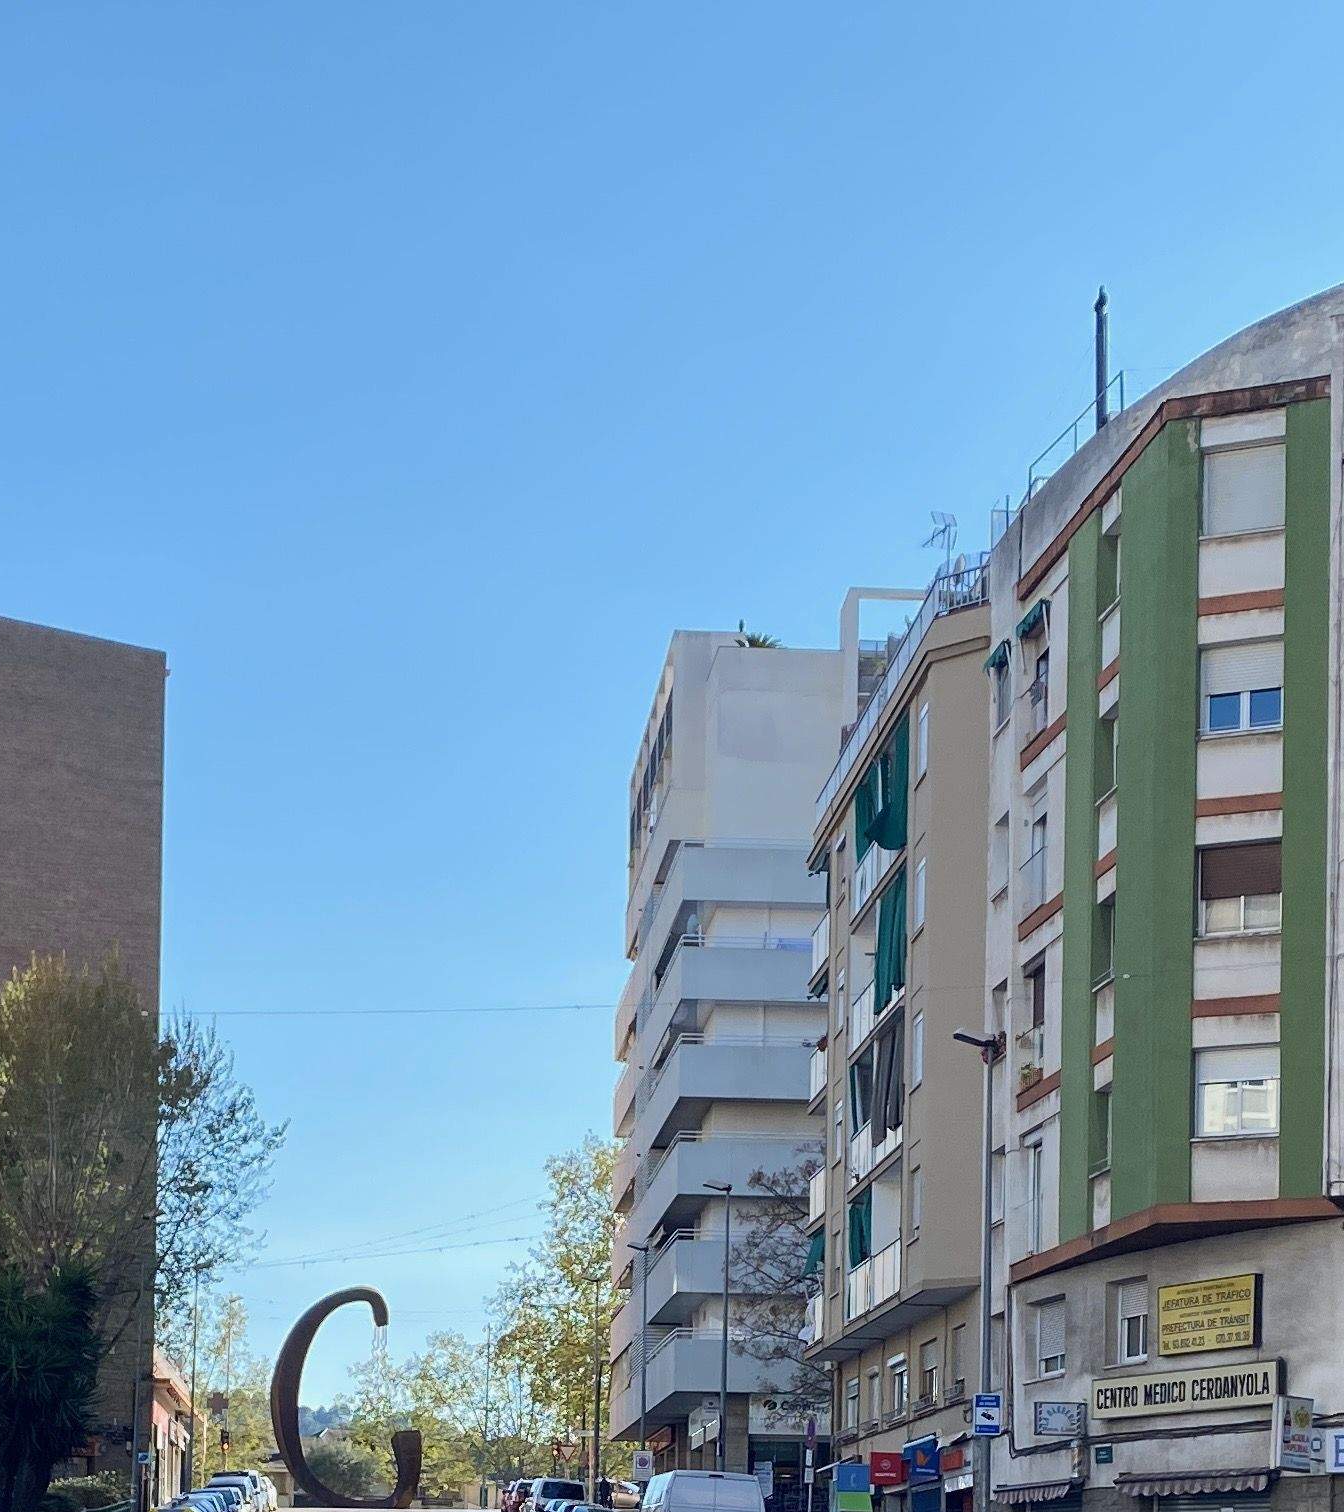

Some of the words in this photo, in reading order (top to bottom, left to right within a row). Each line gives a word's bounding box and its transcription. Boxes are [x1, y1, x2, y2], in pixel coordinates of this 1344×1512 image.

[1096, 1385, 1138, 1410] CENTRO
[1143, 1380, 1186, 1406] MEDICO
[1191, 1371, 1270, 1402] CERDANYOLA
